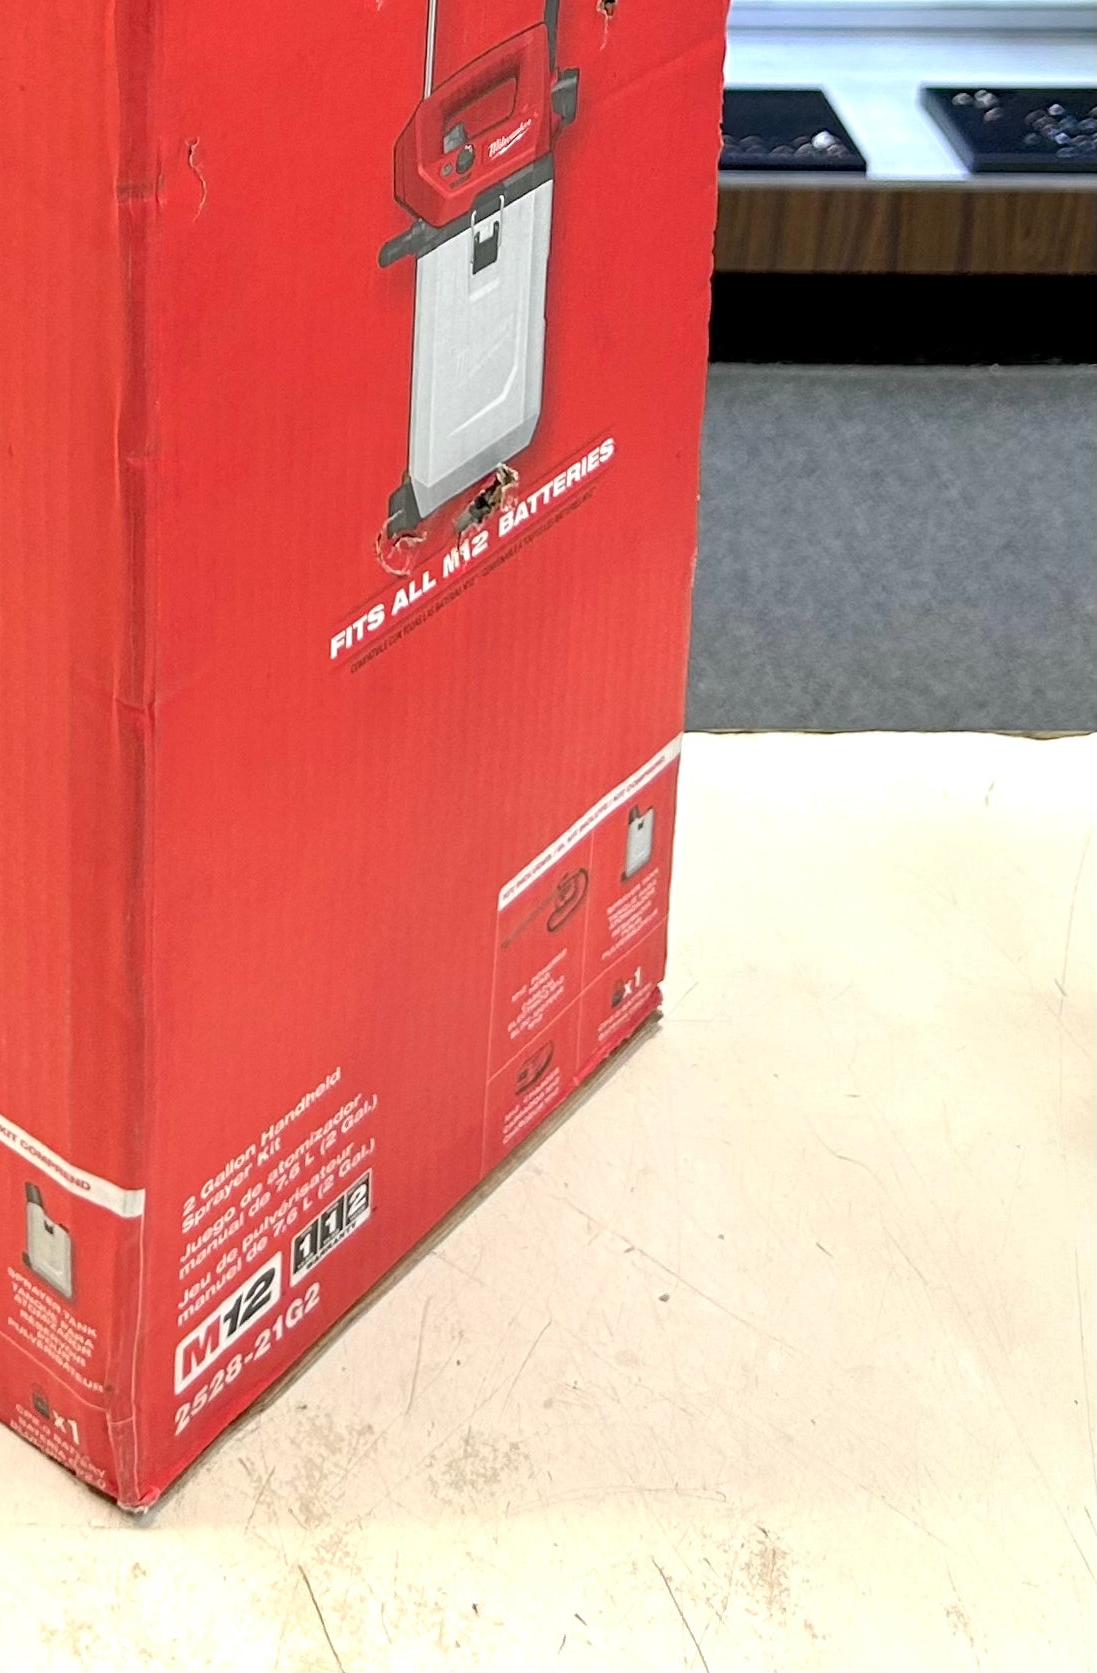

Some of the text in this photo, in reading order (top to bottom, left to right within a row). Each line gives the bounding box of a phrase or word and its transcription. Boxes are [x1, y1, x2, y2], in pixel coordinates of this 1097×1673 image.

[329, 604, 385, 659] FITS
[391, 570, 437, 616] ALL
[498, 438, 615, 538] BATTERIES
[0, 1123, 18, 1143] KIT
[19, 1139, 91, 1191] COMPREND
[178, 1094, 378, 1281] manual de 7.6 L (2 Gal.)
[181, 1093, 363, 1264] Juego de atomizador
[182, 1067, 342, 1215] 2 Gallon Handheld
[182, 1136, 282, 1234] Sprayer Kit
[177, 1256, 242, 1327] manuel
[246, 1232, 268, 1260] de
[303, 1195, 314, 1214] L
[317, 1177, 335, 1201] (2
[338, 1138, 376, 1173] Gal.)
[299, 1234, 313, 1261] 1
[325, 1210, 340, 1236] 1
[348, 1182, 368, 1219] 2
[178, 1273, 212, 1310] Jeu
[216, 1246, 239, 1272] de
[180, 1266, 276, 1380] M12
[174, 1282, 321, 1437] 2528-21G2
